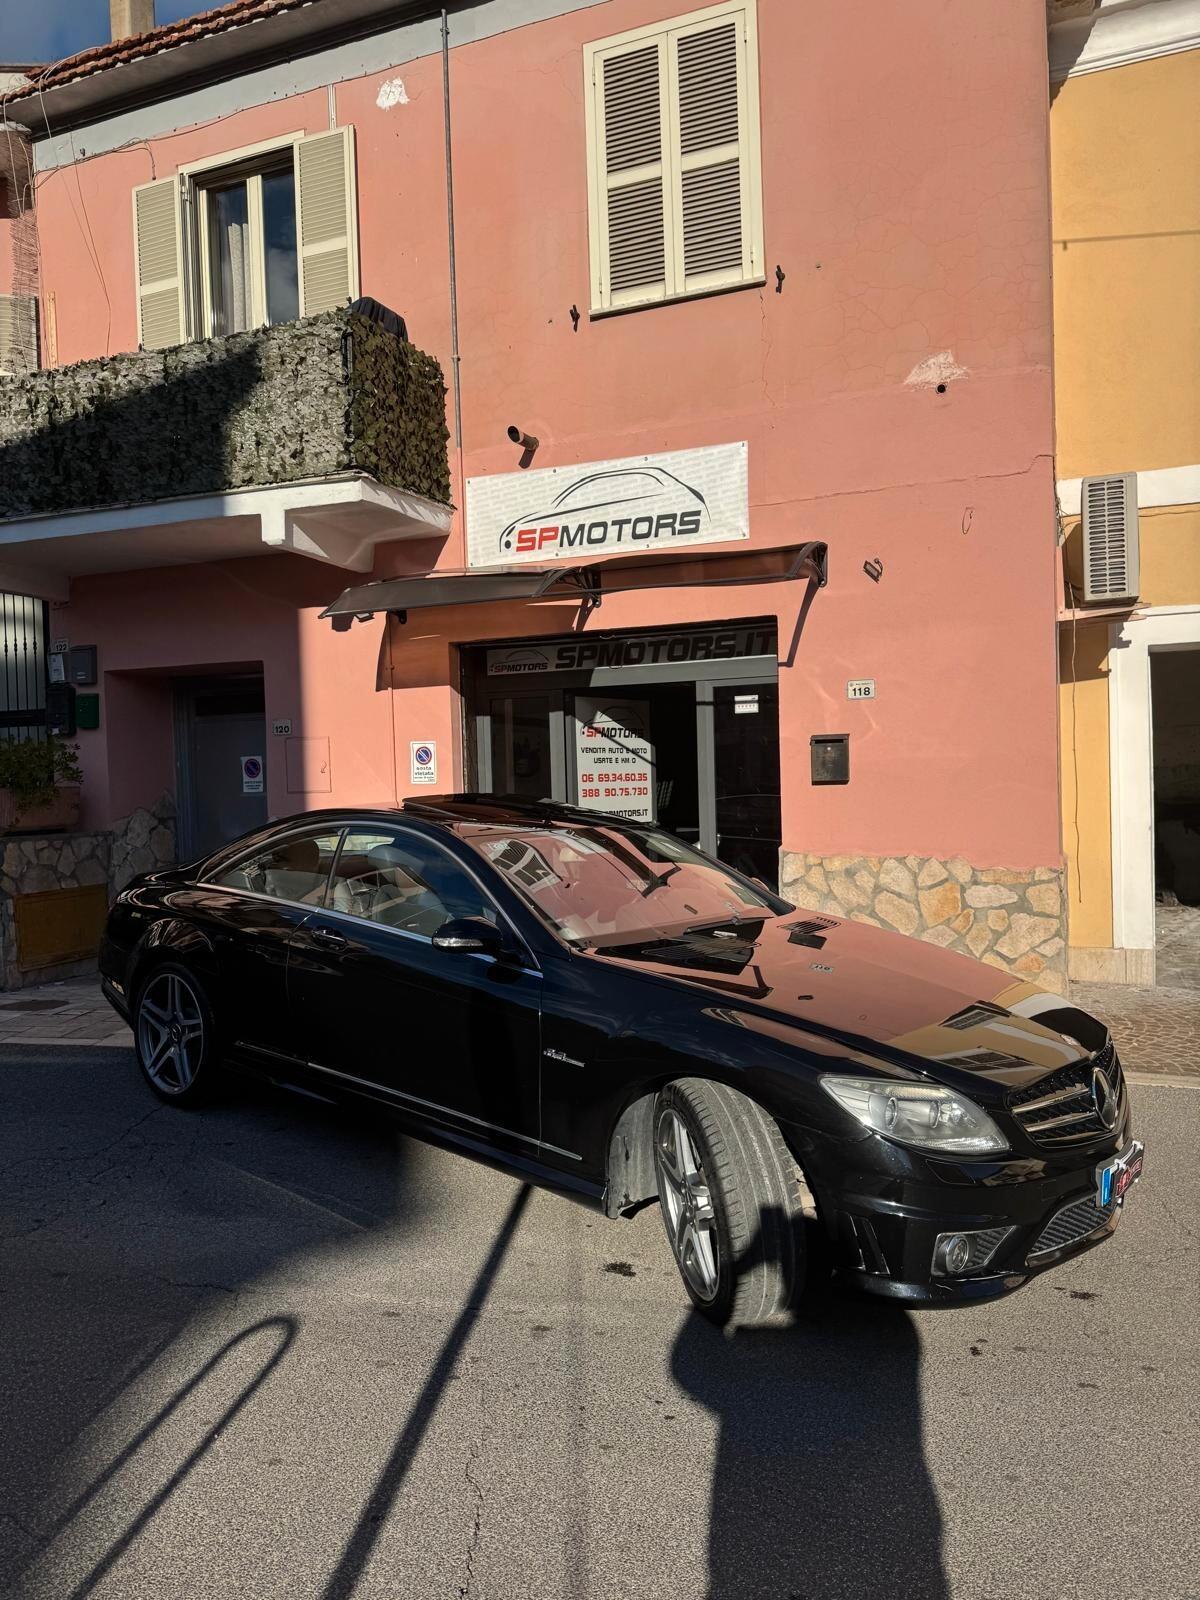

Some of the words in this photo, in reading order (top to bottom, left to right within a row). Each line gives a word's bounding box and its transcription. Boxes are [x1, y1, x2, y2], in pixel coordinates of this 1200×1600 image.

[516, 510, 702, 552] SPMOTORS
[555, 631, 776, 669] SPMOTORS.IT
[494, 662, 548, 672] SPMOTORS
[852, 687, 870, 696] 118
[586, 727, 644, 738] SPMOTORS
[581, 773, 594, 782] 06
[598, 773, 648, 783] 69.34.60.35
[582, 788, 600, 798] 388
[604, 787, 648, 798] 90.75.730
